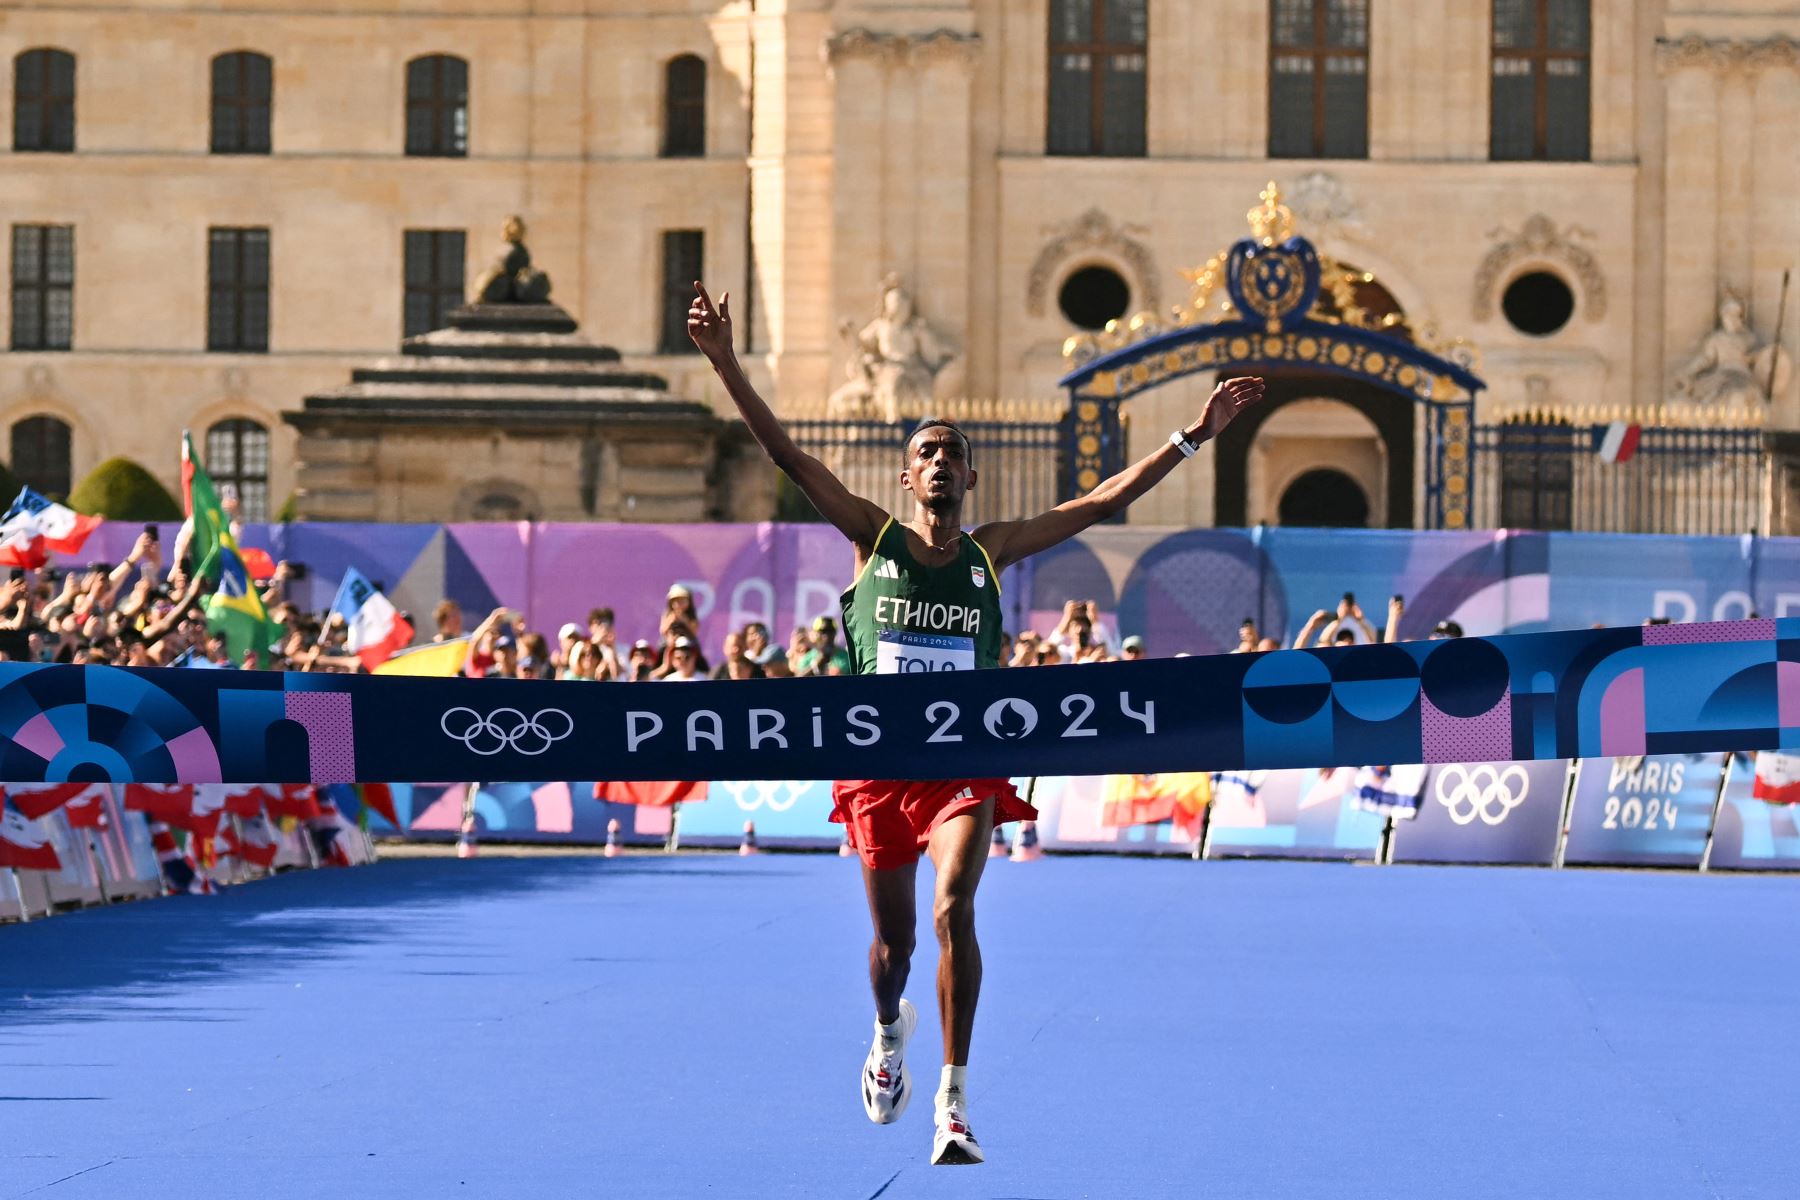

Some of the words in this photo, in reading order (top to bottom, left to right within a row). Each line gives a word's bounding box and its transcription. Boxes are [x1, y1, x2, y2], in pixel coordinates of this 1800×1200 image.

[874, 596, 981, 634] ETHIOPIA
[902, 635, 927, 644] PARIS
[1607, 761, 1685, 795] PARIS
[1602, 796, 1678, 830] 2024
